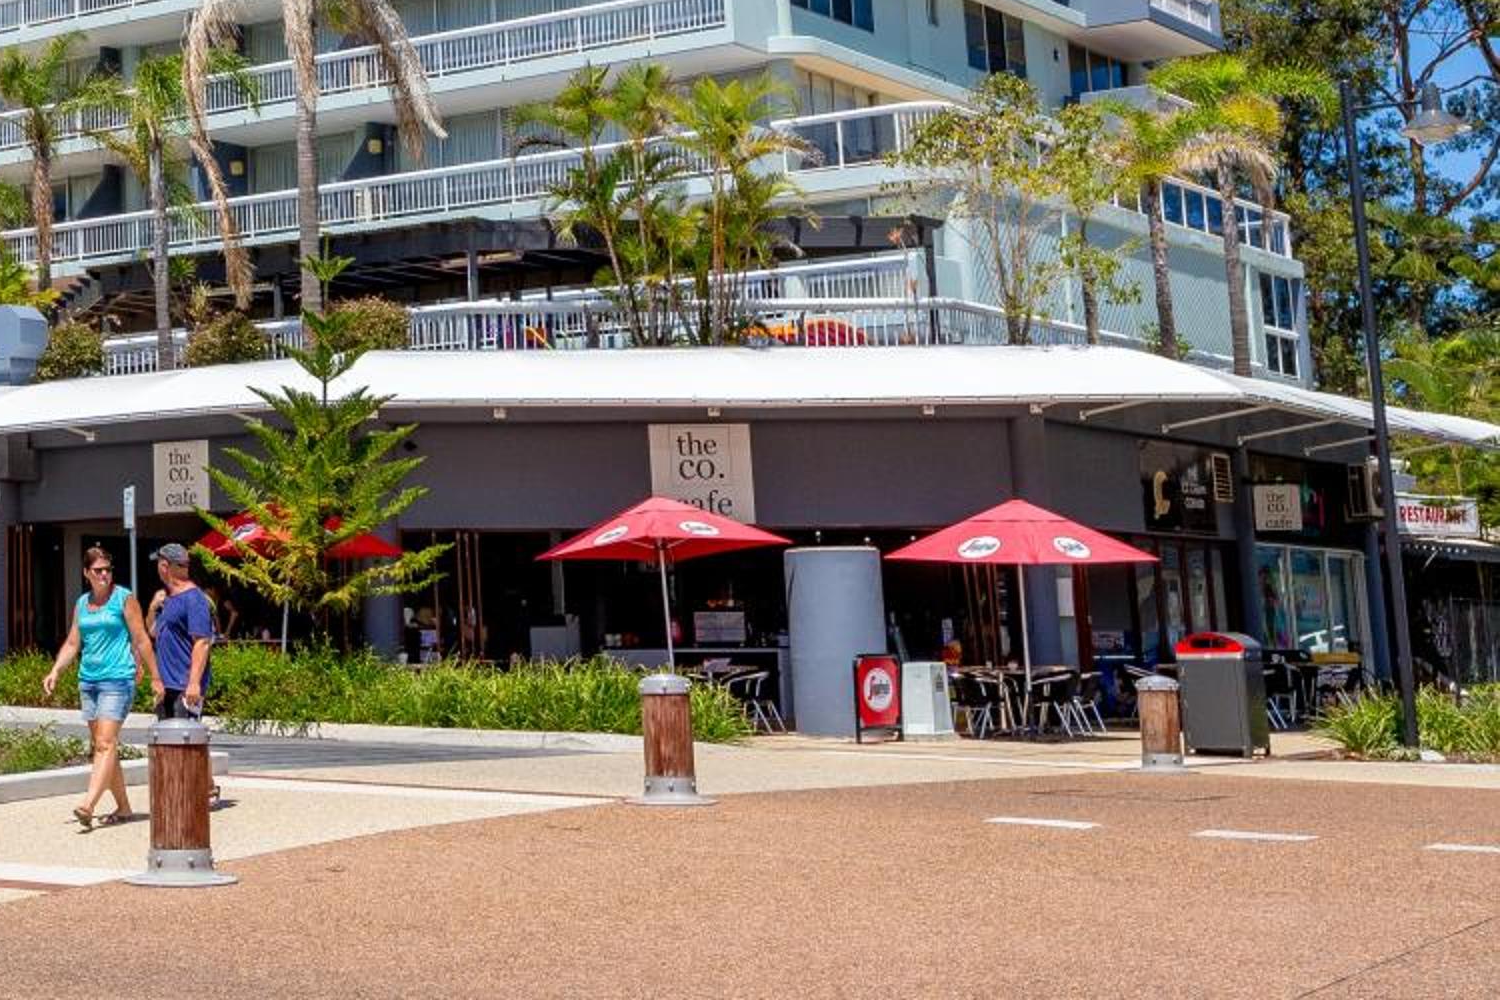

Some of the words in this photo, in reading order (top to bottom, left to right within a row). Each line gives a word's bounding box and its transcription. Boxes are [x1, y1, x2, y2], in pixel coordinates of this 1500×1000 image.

[676, 431, 717, 456] the
[168, 448, 191, 465] the
[168, 467, 195, 482] co.
[678, 458, 725, 480] co.
[165, 487, 197, 507] cafe
[1399, 505, 1468, 524] RESTAURANT
